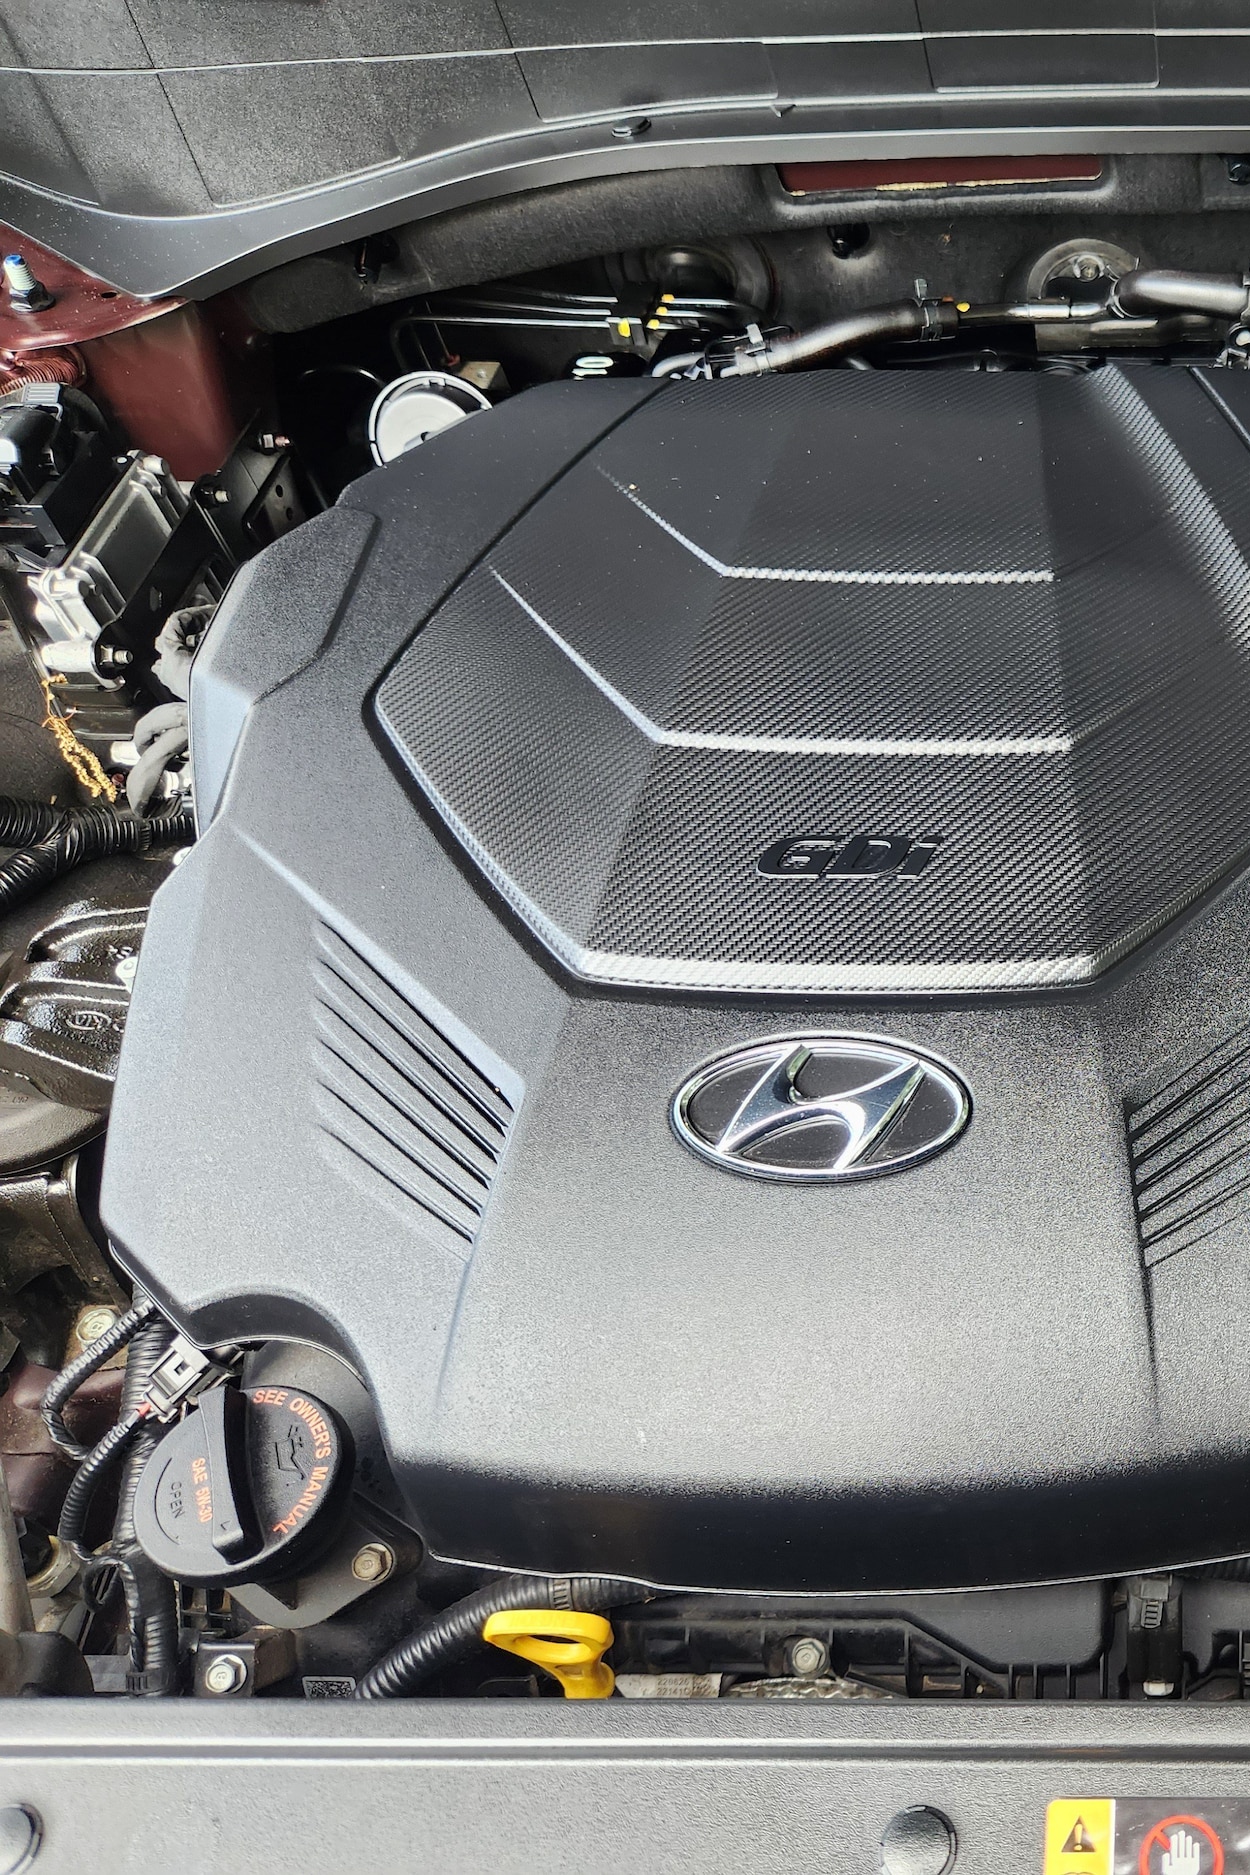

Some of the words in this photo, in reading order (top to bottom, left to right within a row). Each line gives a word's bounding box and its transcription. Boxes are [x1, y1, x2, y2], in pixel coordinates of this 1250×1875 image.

[756, 834, 944, 880] GDi
[253, 1389, 289, 1407] SEE
[289, 1397, 332, 1460] OWNER'S
[191, 1457, 208, 1485] SAE
[169, 1481, 186, 1520] OPEN
[195, 1487, 214, 1524] 5W-30
[272, 1465, 330, 1535] MANUAL
